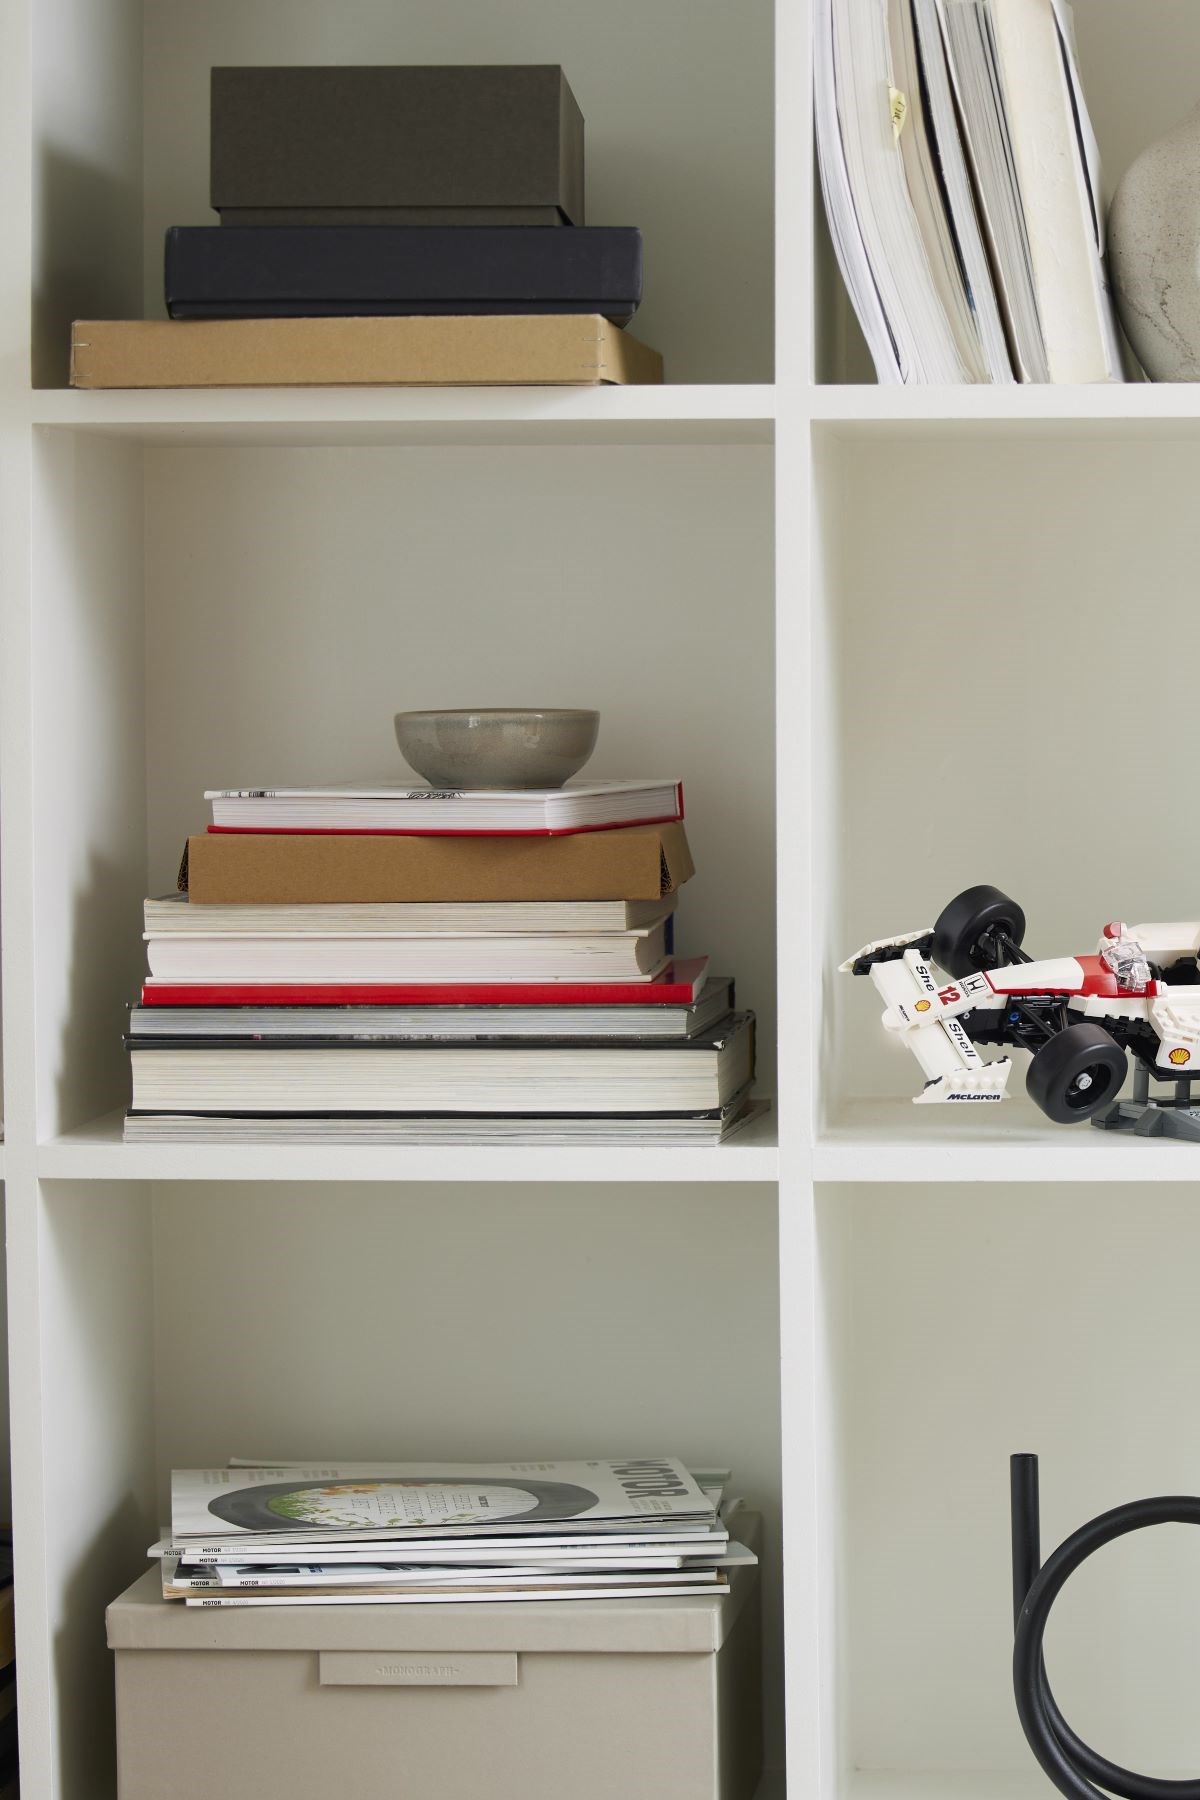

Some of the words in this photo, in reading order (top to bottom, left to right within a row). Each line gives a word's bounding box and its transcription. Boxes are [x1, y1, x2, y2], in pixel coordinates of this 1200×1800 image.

[915, 965, 935, 992] She
[937, 985, 961, 1006] 12
[949, 1023, 977, 1058] Shell
[947, 1093, 1001, 1101] McLaren
[607, 1459, 689, 1499] MOTOR
